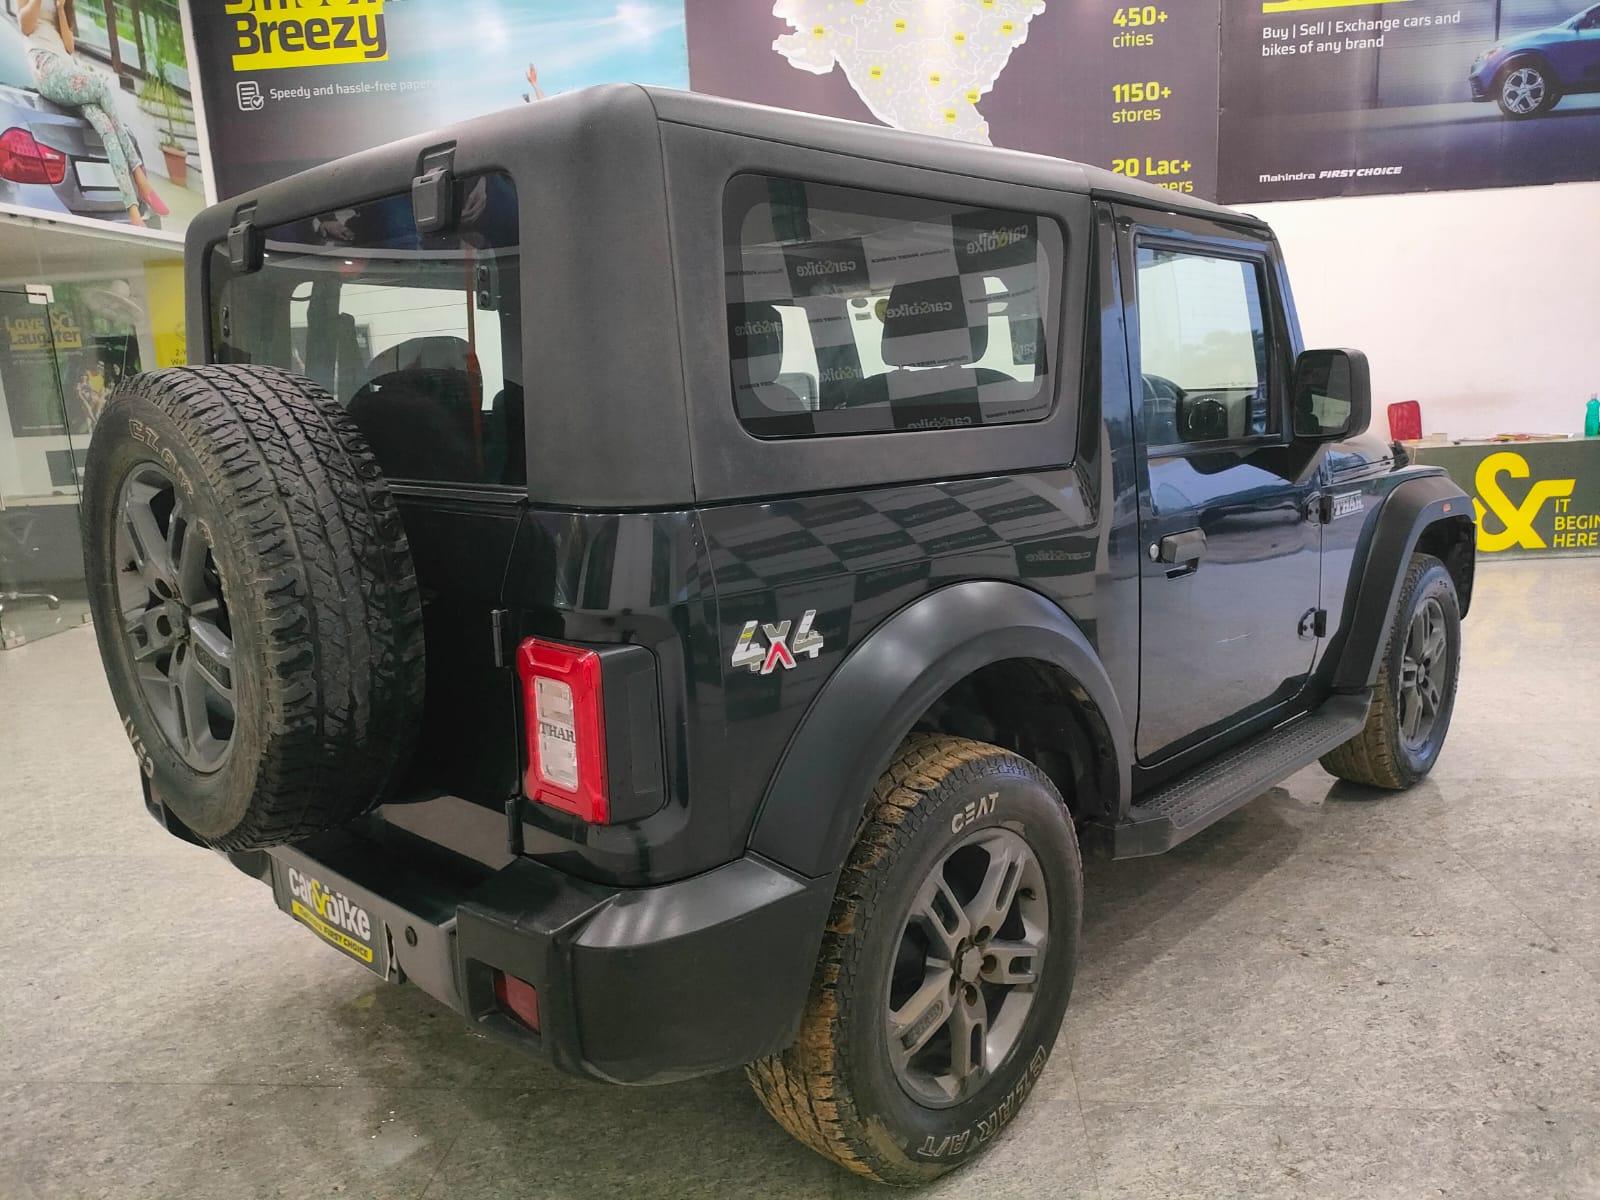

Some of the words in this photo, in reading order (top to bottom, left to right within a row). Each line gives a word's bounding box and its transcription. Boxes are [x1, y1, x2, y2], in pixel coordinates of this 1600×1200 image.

[1112, 5, 1168, 28] 450+
[1262, 27, 1289, 41] Buy
[1299, 22, 1325, 36] Sell
[1335, 18, 1400, 33] Exchange
[1403, 13, 1431, 28] cars
[1435, 11, 1461, 25] and
[228, 12, 388, 59] Breezy
[1112, 31, 1154, 48] cities
[1262, 43, 1296, 57] bikes
[1299, 40, 1314, 54] of
[1316, 40, 1342, 54] any
[1345, 35, 1385, 50] brand
[269, 86, 311, 101] Speedy
[312, 84, 334, 96] and
[336, 80, 398, 95] hassle-free
[1112, 81, 1172, 104] 1150+
[1112, 108, 1161, 123] stores
[1112, 157, 1140, 178] 20
[1145, 157, 1192, 177] Lac+
[1259, 172, 1316, 183] Mahindra
[1318, 169, 1356, 179] FIRST
[1356, 166, 1403, 177] CHOICE
[1554, 498, 1572, 514] IT
[1552, 532, 1598, 548] HERE
[951, 791, 1000, 834] CEAT
